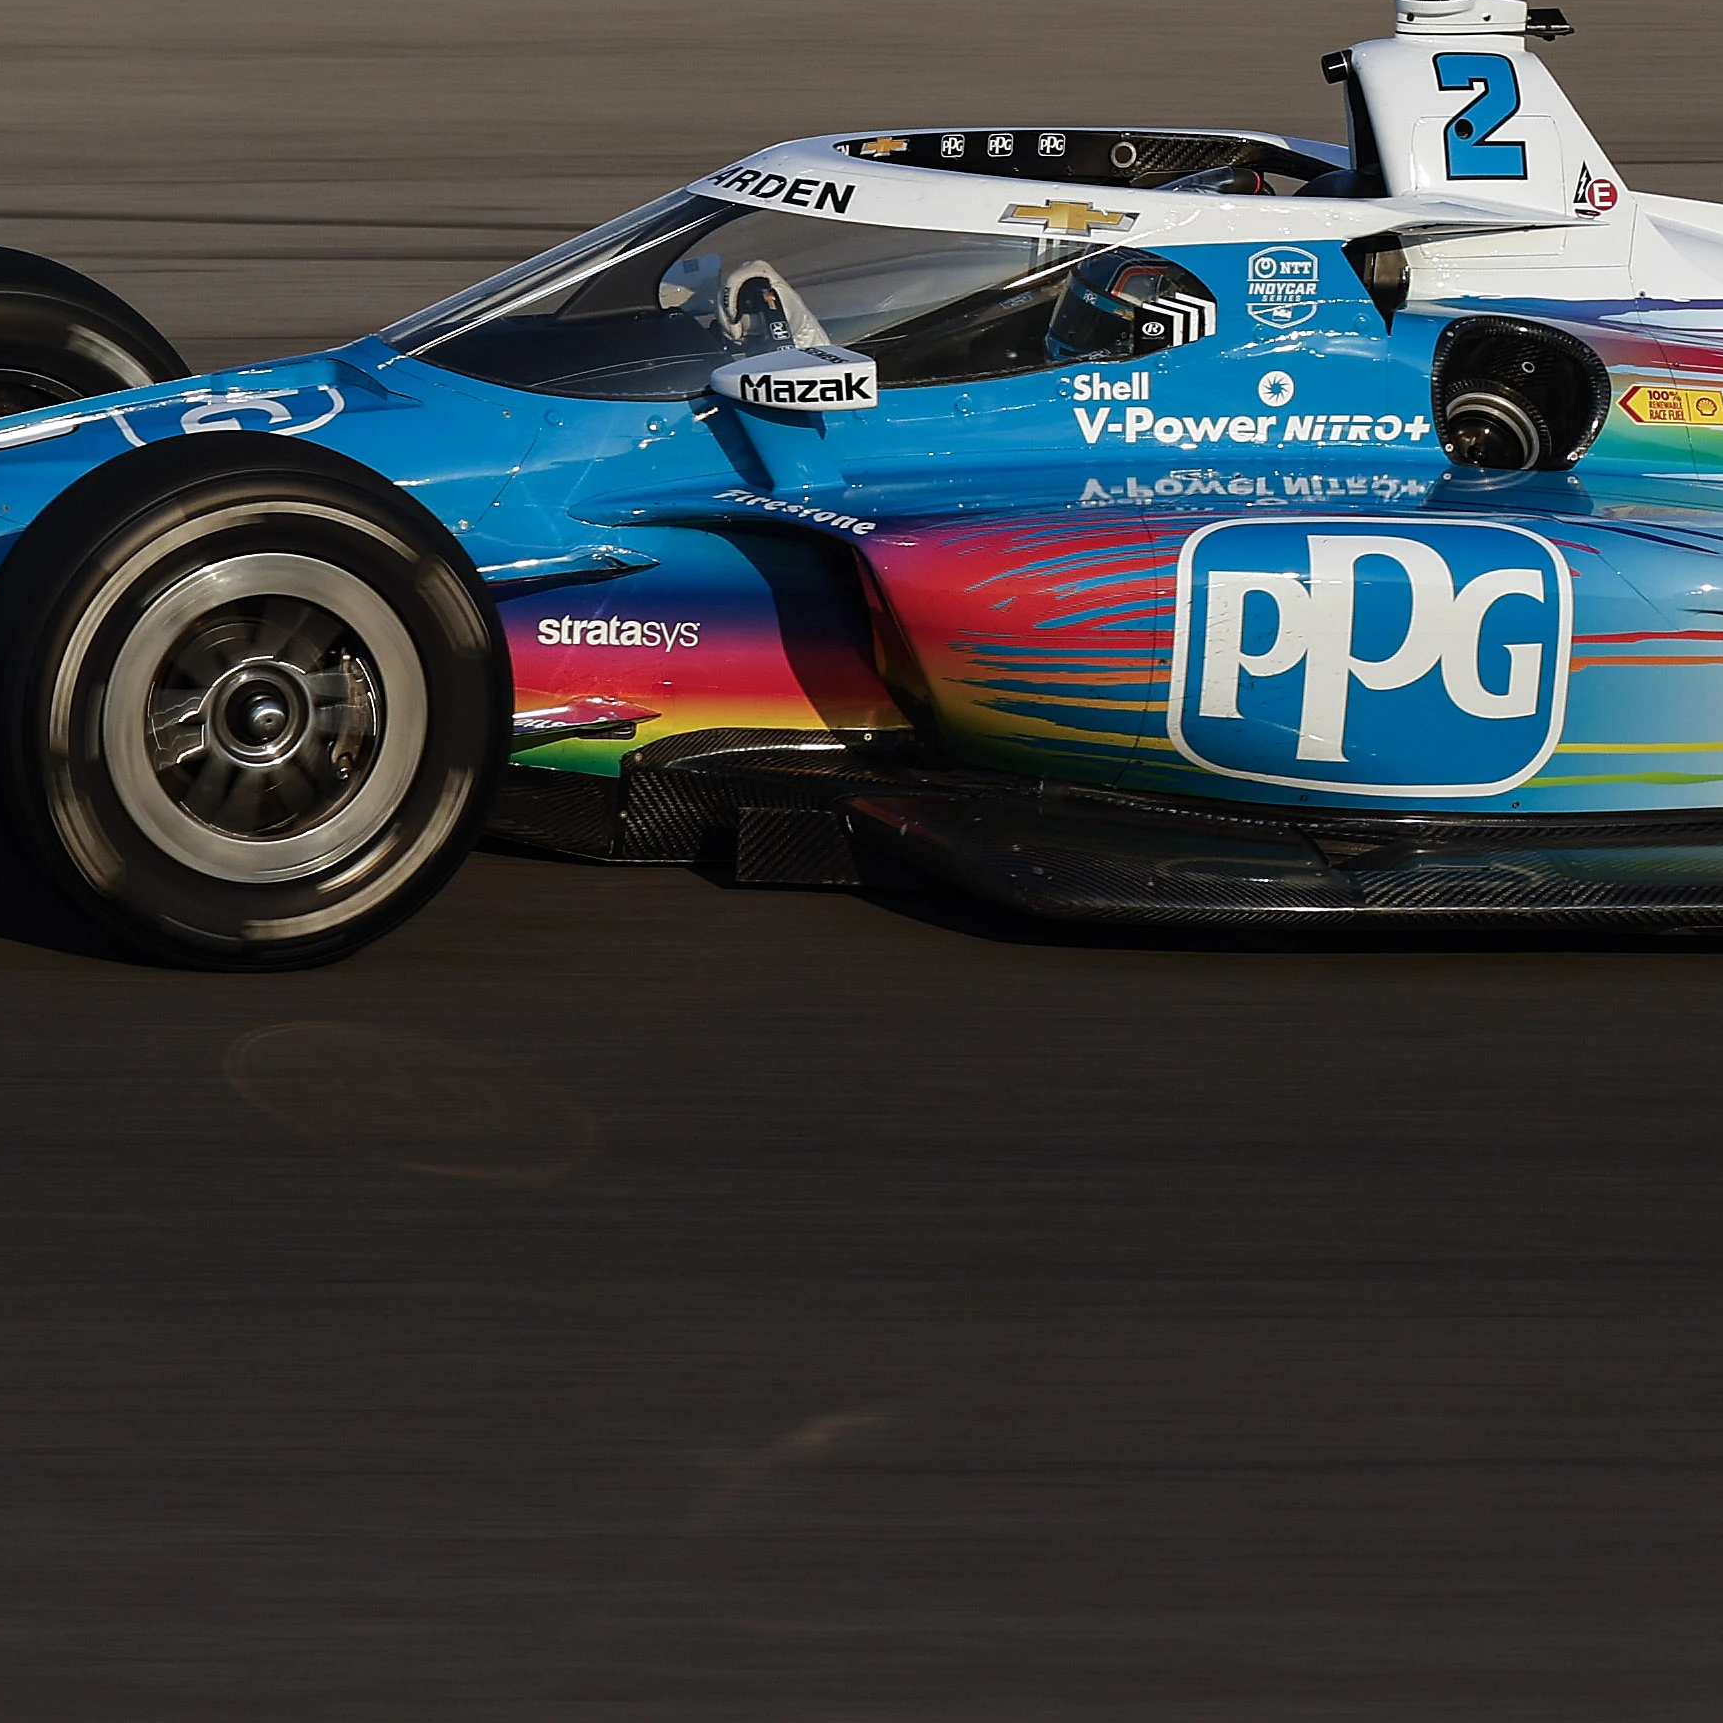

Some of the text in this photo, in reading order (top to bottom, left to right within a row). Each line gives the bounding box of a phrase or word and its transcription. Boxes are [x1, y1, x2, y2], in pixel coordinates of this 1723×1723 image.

[1432, 52, 1528, 180] 2
[941, 135, 964, 155] PPG
[988, 135, 1012, 155] PPG
[1039, 135, 1064, 155] PPG
[1593, 183, 1613, 208] E
[1279, 261, 1312, 274] NTT
[1248, 282, 1317, 295] INDYCAR
[740, 373, 872, 402] Mazak
[1074, 372, 1149, 401] Shell
[1648, 390, 1682, 401] 100%
[1074, 407, 1277, 444] V-Power
[1649, 410, 1667, 421] RACE
[1668, 410, 1685, 421] FUEL
[712, 489, 876, 535] Firestone
[537, 614, 700, 653] stratasys
[1199, 535, 1545, 762] PPG
